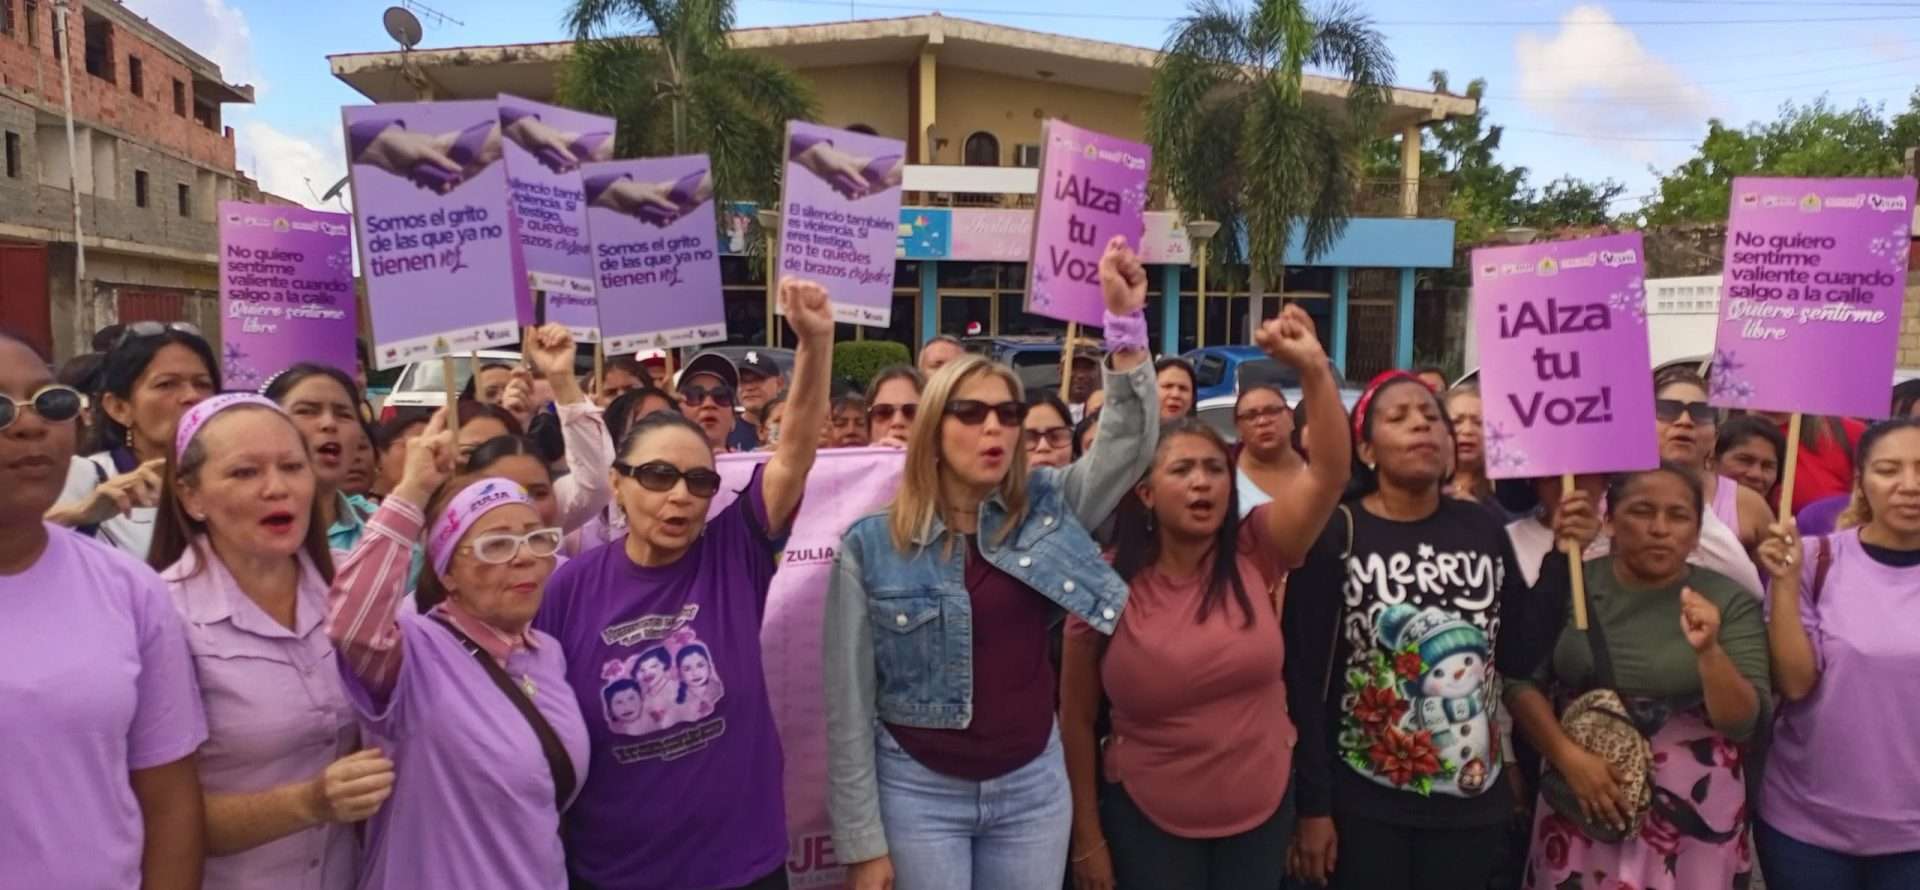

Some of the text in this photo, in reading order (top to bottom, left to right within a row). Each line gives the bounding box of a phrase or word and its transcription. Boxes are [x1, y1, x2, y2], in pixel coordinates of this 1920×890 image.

[366, 214, 427, 234] Somos
[430, 208, 445, 226] el
[448, 205, 488, 228] grito
[528, 219, 579, 237] quedes
[789, 203, 894, 232] El silencio también
[369, 225, 502, 253] de las que ya no
[787, 231, 811, 242] eres
[788, 219, 800, 228] es
[803, 220, 855, 238] violencia.
[1068, 213, 1097, 247] tu
[598, 236, 701, 257] Somos el grito
[1735, 231, 1836, 251] No quiero
[227, 245, 304, 263] No quiero
[600, 250, 713, 271] de las que ya no
[786, 243, 871, 265] no te quedes
[1732, 250, 1822, 267] sentirme
[228, 261, 295, 276] sentirme
[371, 253, 437, 277] tienen
[784, 258, 801, 271] de
[804, 260, 846, 278] brazos
[1050, 245, 1102, 286] Voz
[228, 275, 348, 292] valiente cuando
[601, 271, 656, 288] tienen
[1731, 266, 1895, 287] valiente cuando
[228, 288, 336, 304] salgo a la calle
[1729, 283, 1875, 304] salgo a la calle
[1726, 300, 1887, 324] Quiero sentirme
[242, 317, 277, 334] libre
[1741, 319, 1787, 340] libre
[1533, 347, 1582, 381] tu
[1507, 386, 1613, 429] Voz!
[786, 547, 834, 563] ZULIA
